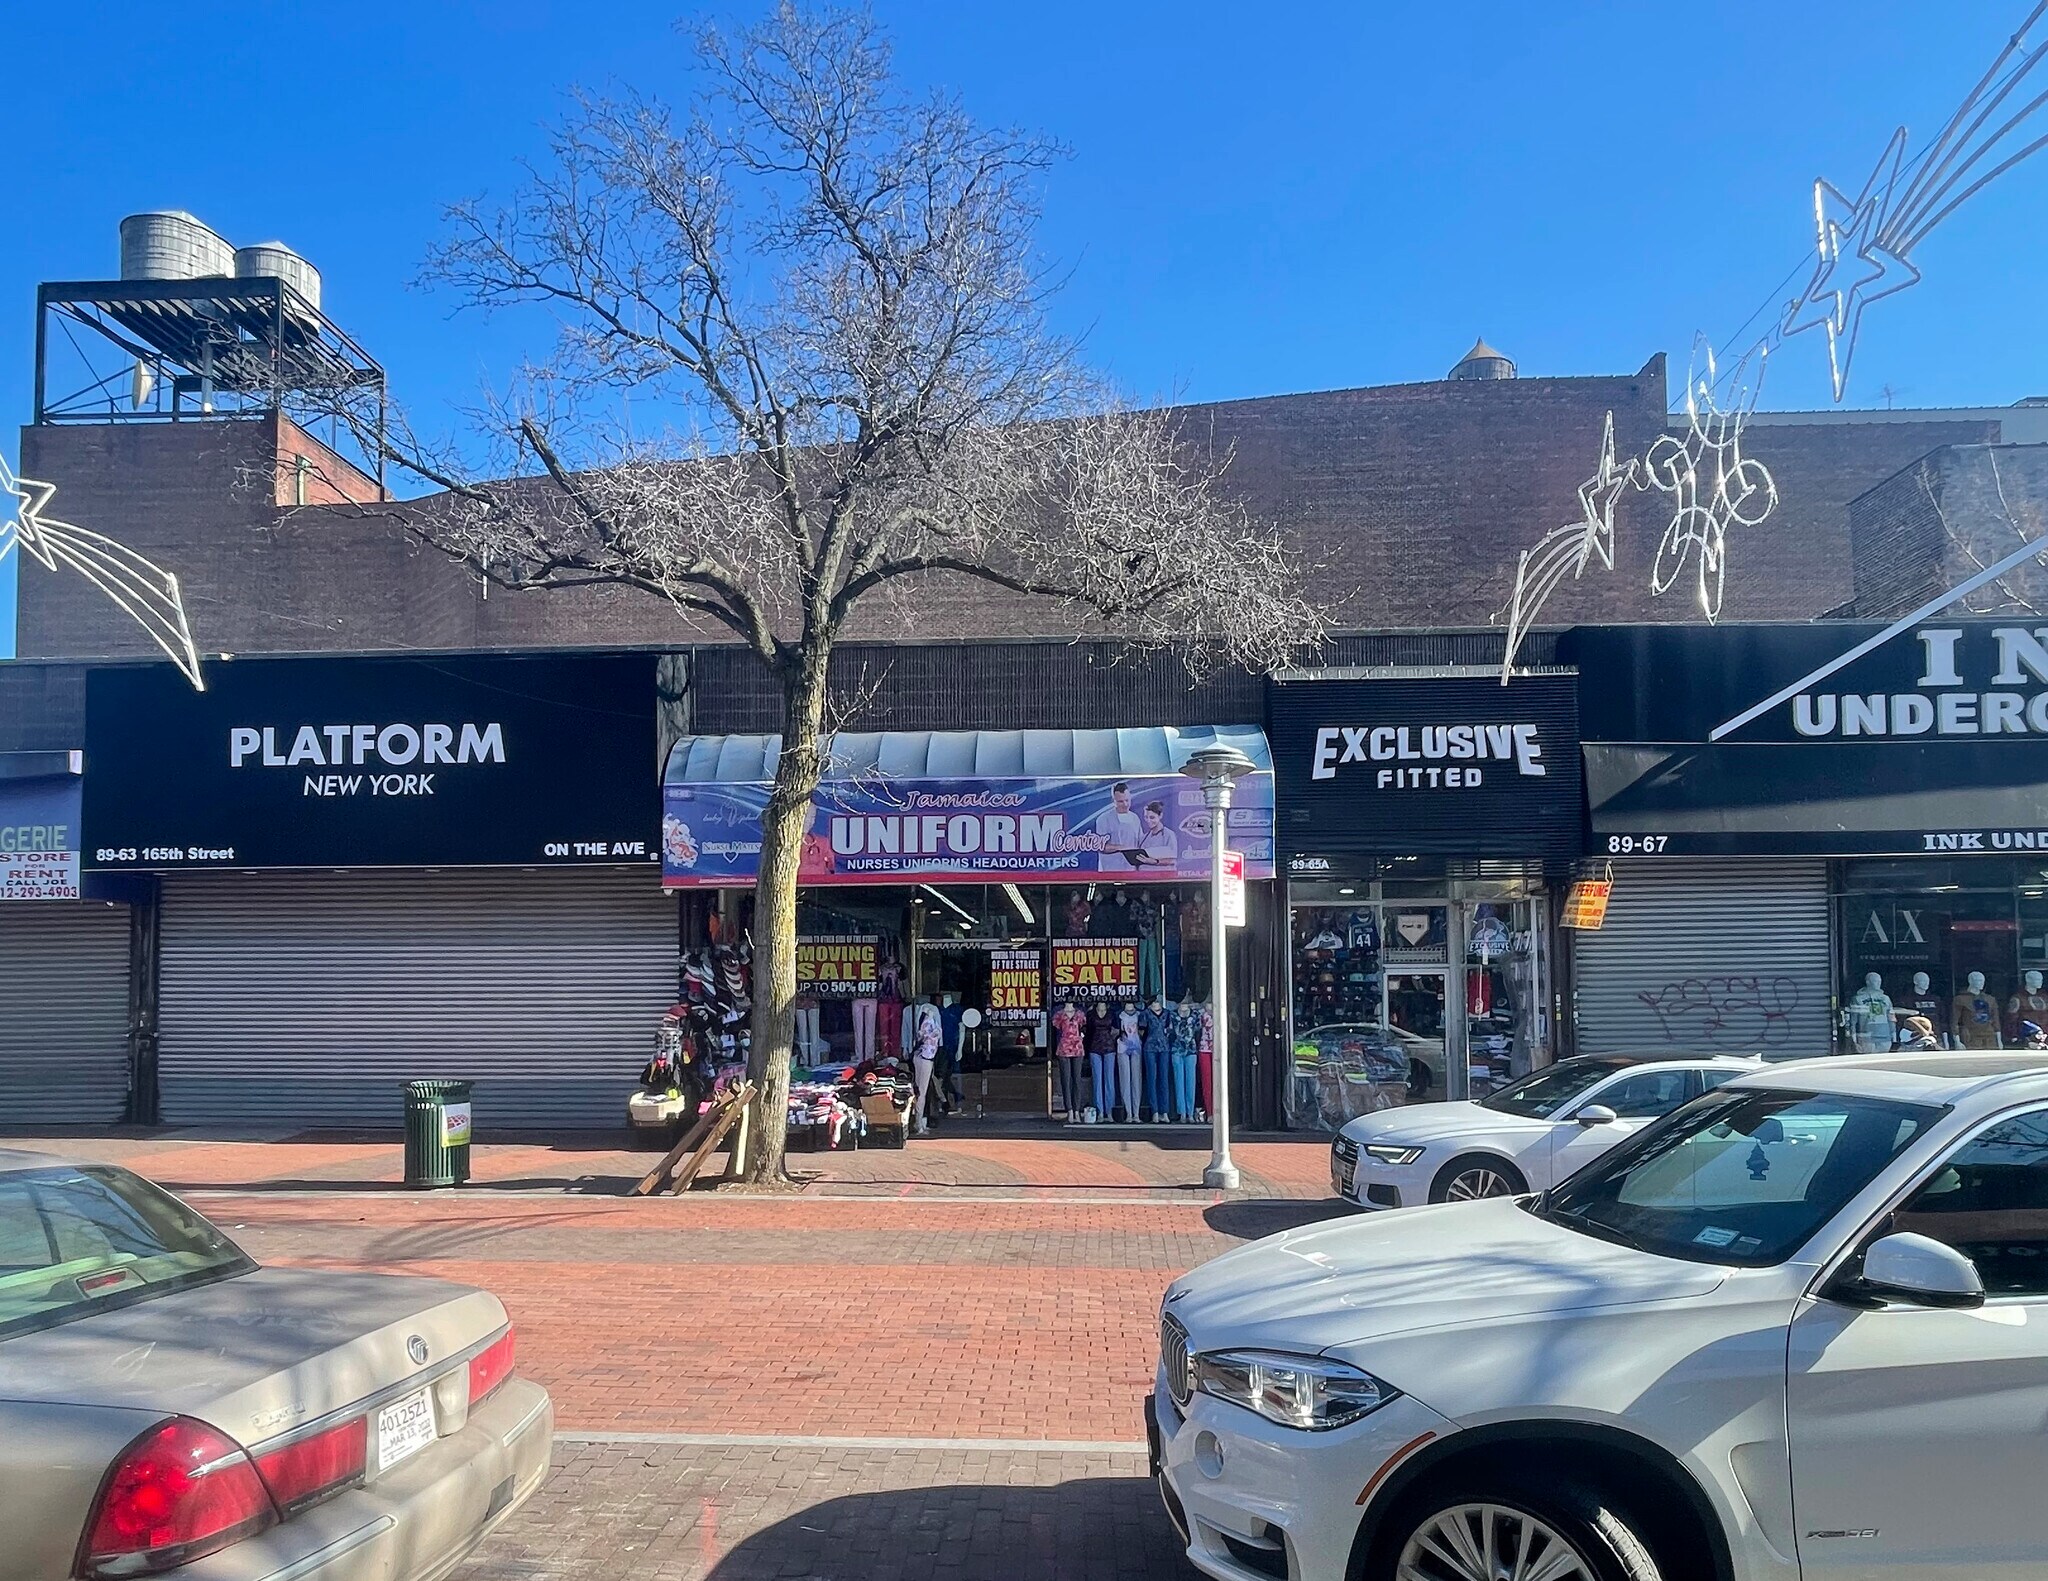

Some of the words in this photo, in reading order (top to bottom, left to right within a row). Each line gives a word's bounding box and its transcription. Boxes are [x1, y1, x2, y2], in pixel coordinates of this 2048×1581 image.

[230, 723, 506, 767] PLATFORM
[1311, 724, 1546, 780] EXCLUSIVE
[303, 775, 362, 796] NEW
[369, 774, 435, 796] YORK
[1377, 768, 1482, 788] FITTED
[900, 790, 1027, 811] Jamaica
[1, 825, 68, 852] GERIE
[830, 814, 1064, 854] UNIFORM
[1053, 830, 1111, 853] Center
[1923, 833, 1985, 850] INK
[544, 843, 568, 856] ON
[574, 842, 607, 855] THE
[612, 842, 645, 855] AVE
[1608, 836, 1668, 852] 89-67
[0, 853, 71, 862] STORE
[96, 848, 137, 861] 89-63
[142, 847, 183, 860] 165th
[188, 847, 234, 860] Street
[847, 858, 899, 869] NURSES
[903, 858, 969, 869] UNIFORMS
[973, 857, 1079, 869] HEADQUARTERS
[8, 869, 68, 878] RENT
[798, 945, 875, 961] MOVING
[1468, 941, 1511, 952] EXCUSIVE
[1056, 949, 1134, 966] MOVING
[797, 962, 876, 980] SALE
[991, 971, 1040, 987] MOVING
[1055, 966, 1137, 984] SALE
[813, 982, 829, 992] TO
[831, 981, 856, 992] 50%
[858, 981, 877, 992] OFF
[1053, 986, 1070, 996] UP
[1072, 986, 1089, 996] TO
[1091, 985, 1117, 996] 50%
[1118, 985, 1138, 996] OFF
[992, 988, 1040, 1008] SALE
[1008, 1009, 1025, 1020] 50%
[1027, 1009, 1040, 1020] OFF
